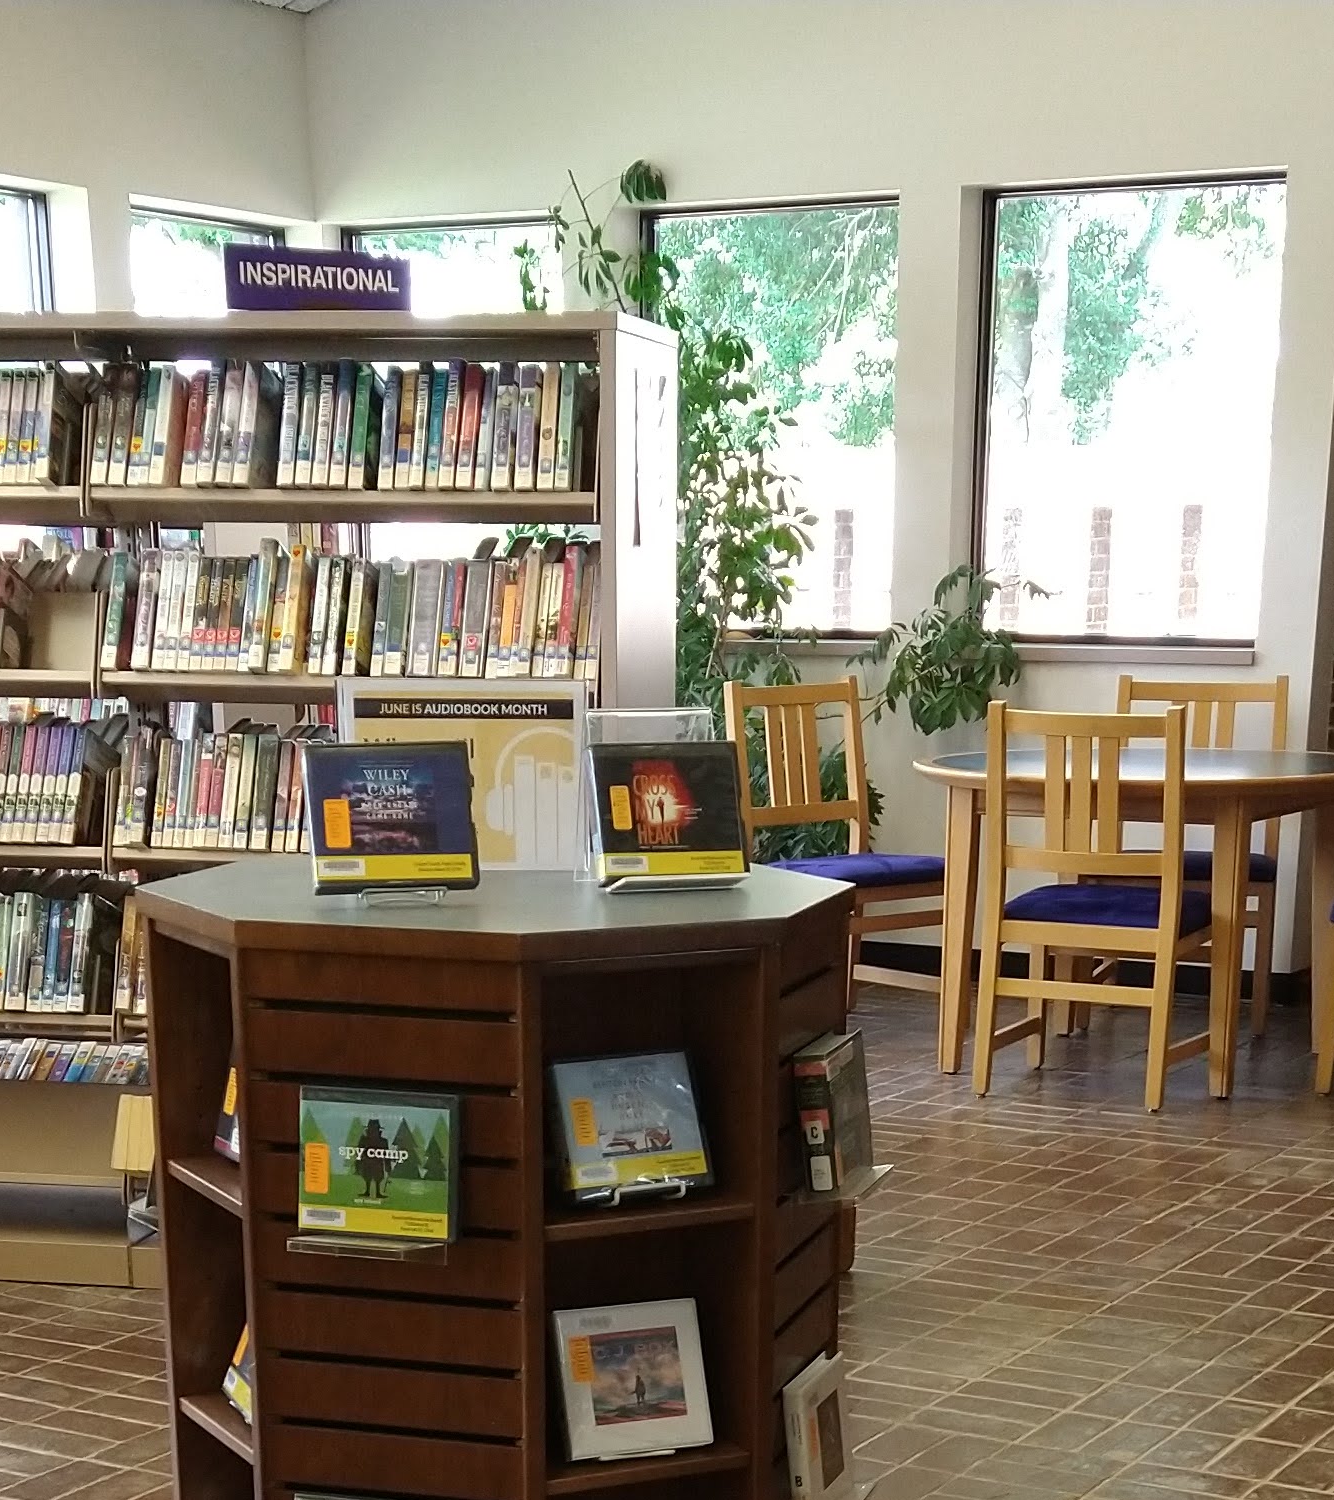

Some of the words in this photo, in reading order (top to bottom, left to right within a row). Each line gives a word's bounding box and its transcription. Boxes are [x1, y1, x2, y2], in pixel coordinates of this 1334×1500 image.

[239, 261, 399, 293] INSPIRATIONAL
[379, 703, 410, 715] JUNE
[411, 703, 423, 714] IS
[424, 703, 500, 715] AUDIOBOOK
[501, 703, 548, 716] MONTH
[362, 768, 410, 781] WILEY
[367, 783, 408, 797] CASH
[637, 822, 680, 845] HEART
[810, 1126, 818, 1139] C
[338, 1145, 366, 1161] spy
[366, 1147, 409, 1164] camp
[794, 1475, 803, 1487] B
